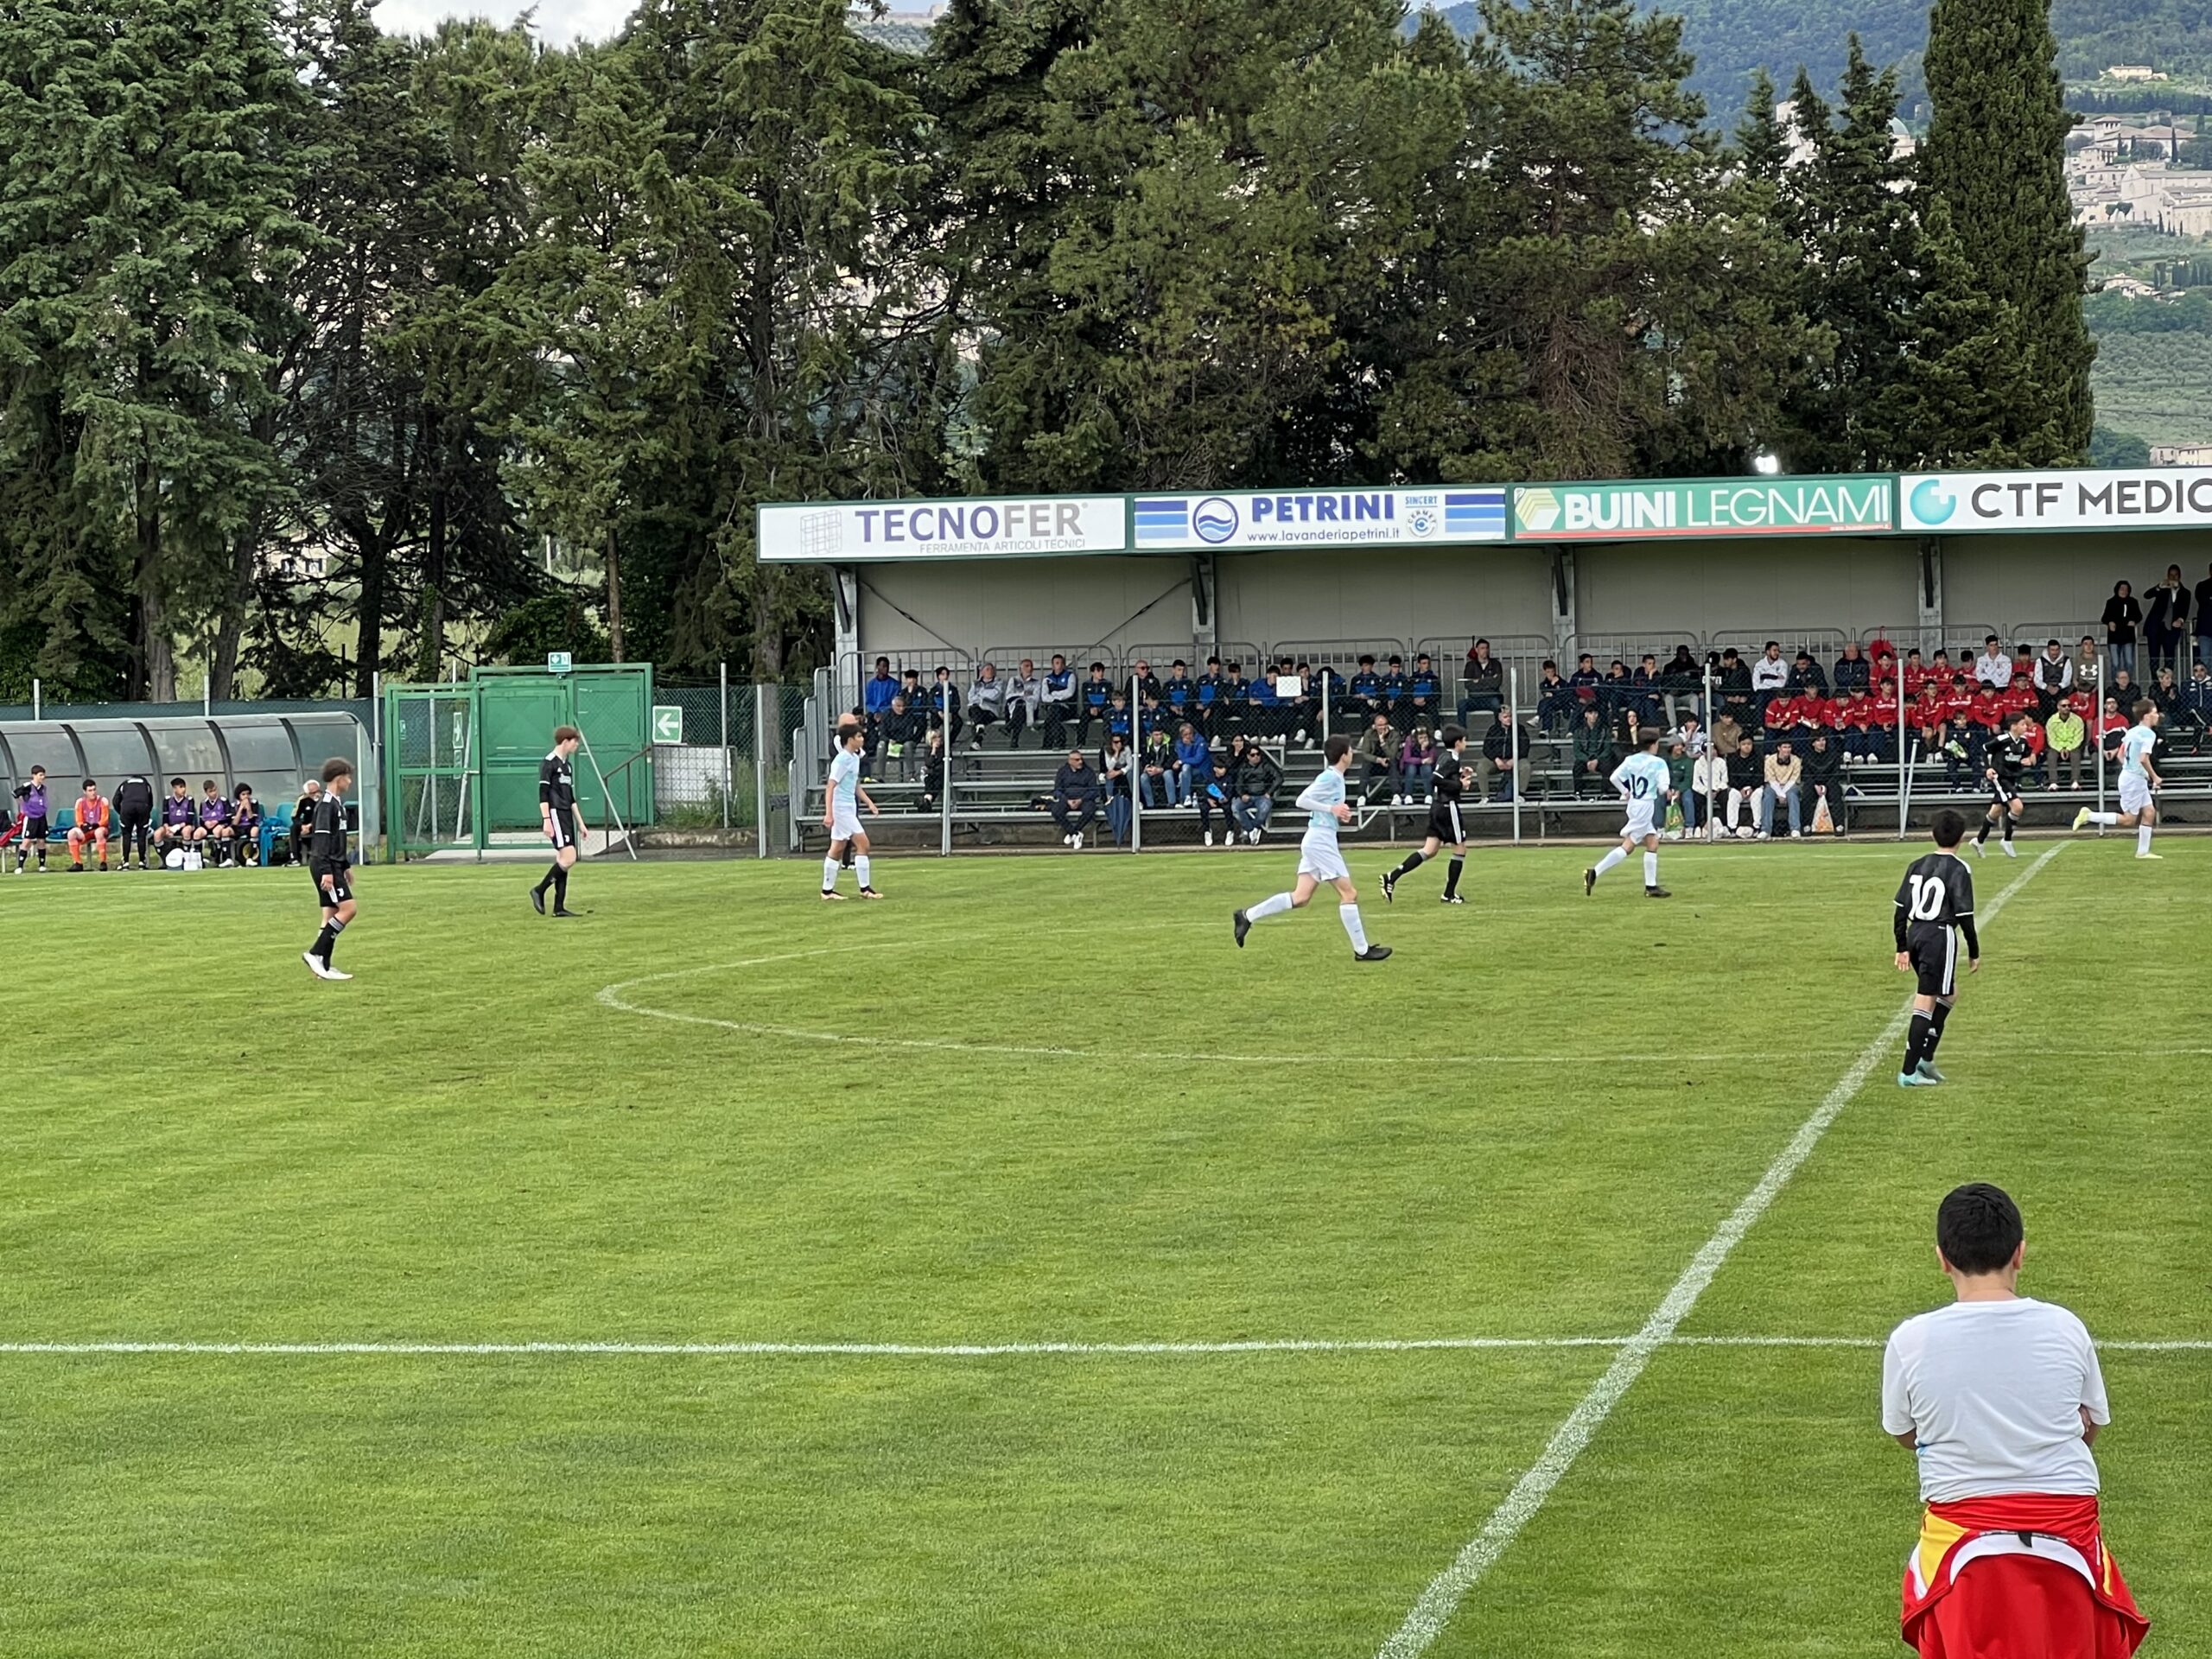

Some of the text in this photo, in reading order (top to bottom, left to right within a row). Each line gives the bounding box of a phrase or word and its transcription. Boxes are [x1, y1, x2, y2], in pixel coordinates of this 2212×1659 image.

[1252, 494, 1395, 523] PETRINI
[1565, 485, 1888, 530] BUINI LEGNAMI
[1972, 481, 2063, 518] CTF
[855, 503, 1085, 543] TECNOFER
[1247, 528, 1400, 543] www.lavanderiapetrini.it
[920, 539, 1085, 554] FERRAMENTA ARTICOLI TECNICI
[1909, 874, 1946, 921] 10
